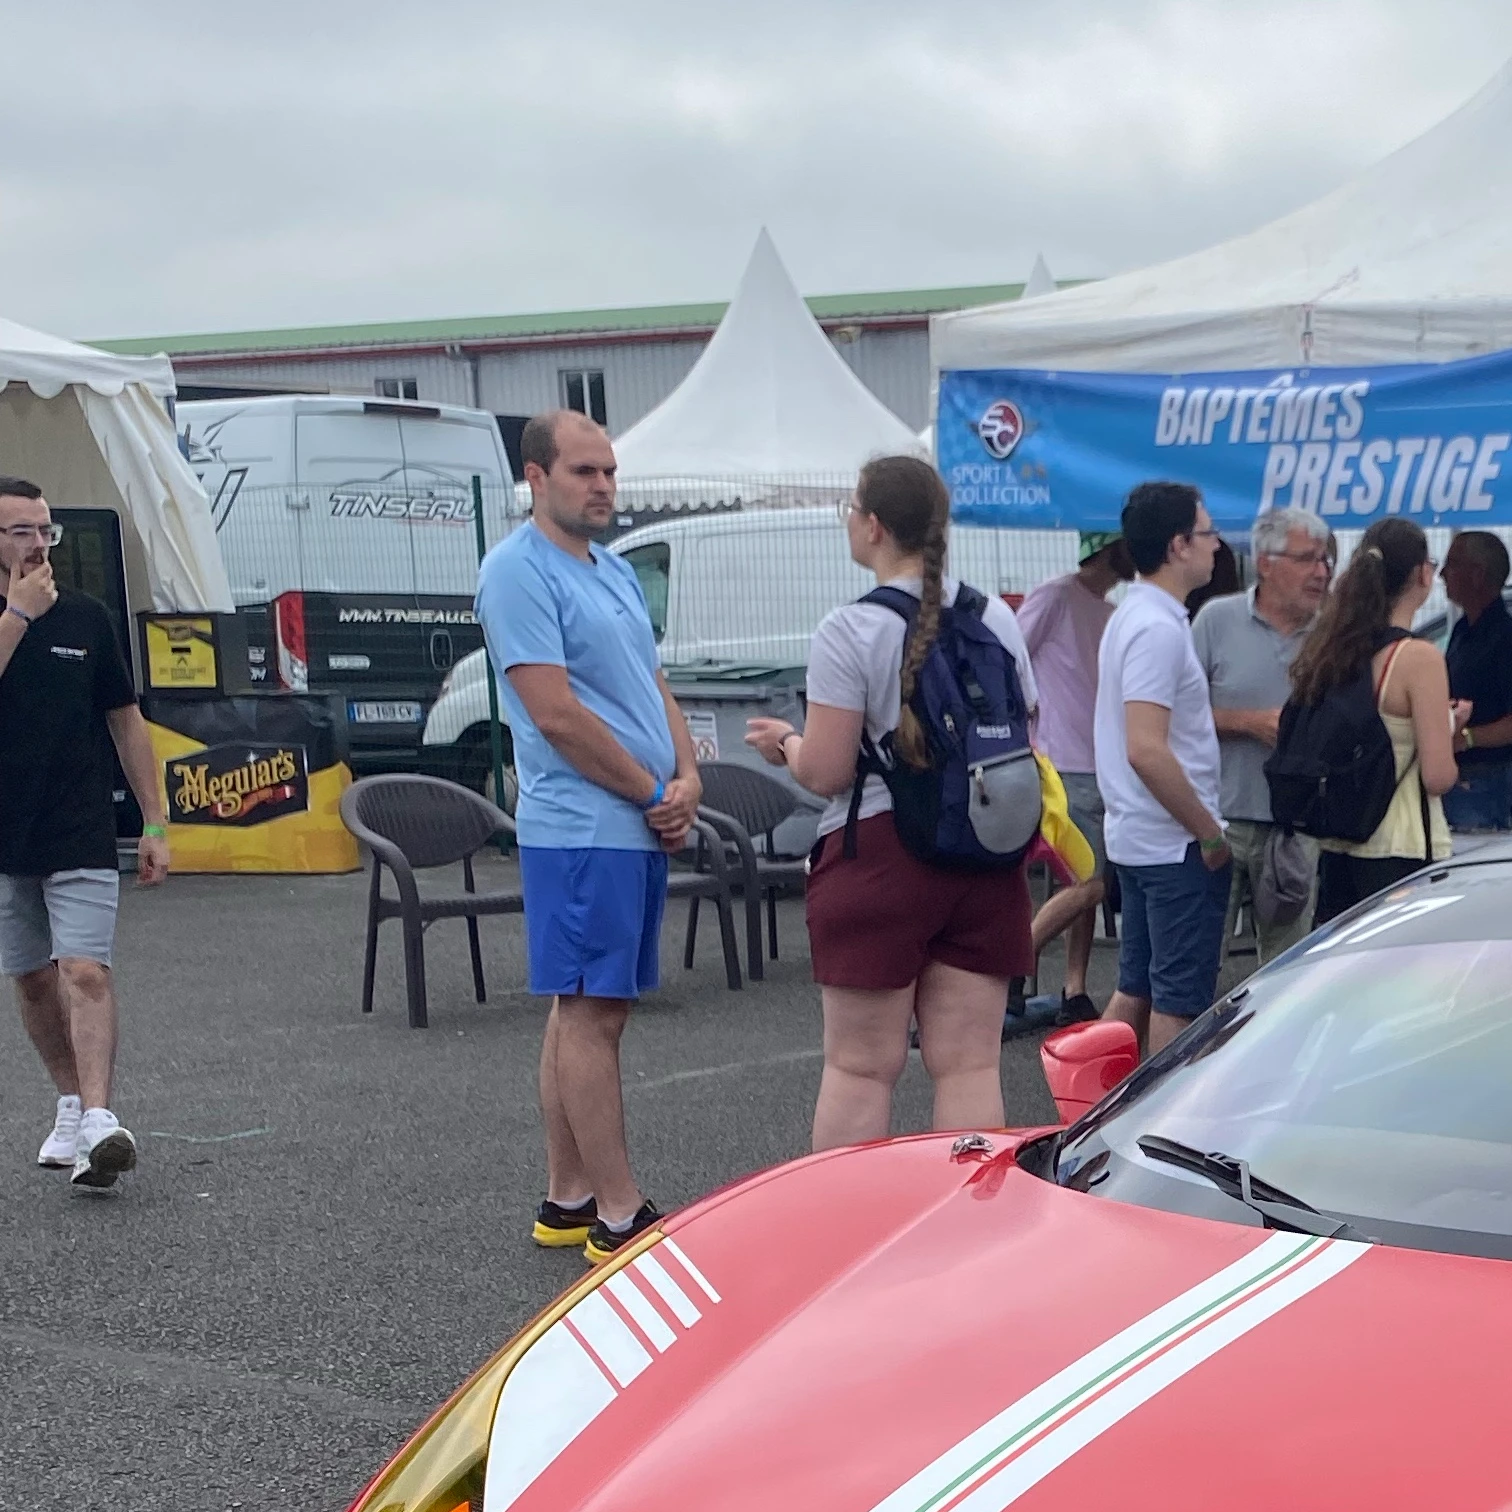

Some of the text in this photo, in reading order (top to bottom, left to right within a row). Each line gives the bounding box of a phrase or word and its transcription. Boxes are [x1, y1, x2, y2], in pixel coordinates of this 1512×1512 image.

[1154, 371, 1371, 447] BAPTÊMES
[951, 484, 1051, 505] COLLECTION
[952, 462, 1000, 485] SPORT
[1257, 433, 1512, 517] PRESTIGE
[328, 491, 476, 523] TINSEAU
[173, 749, 297, 819] Meguiar's
